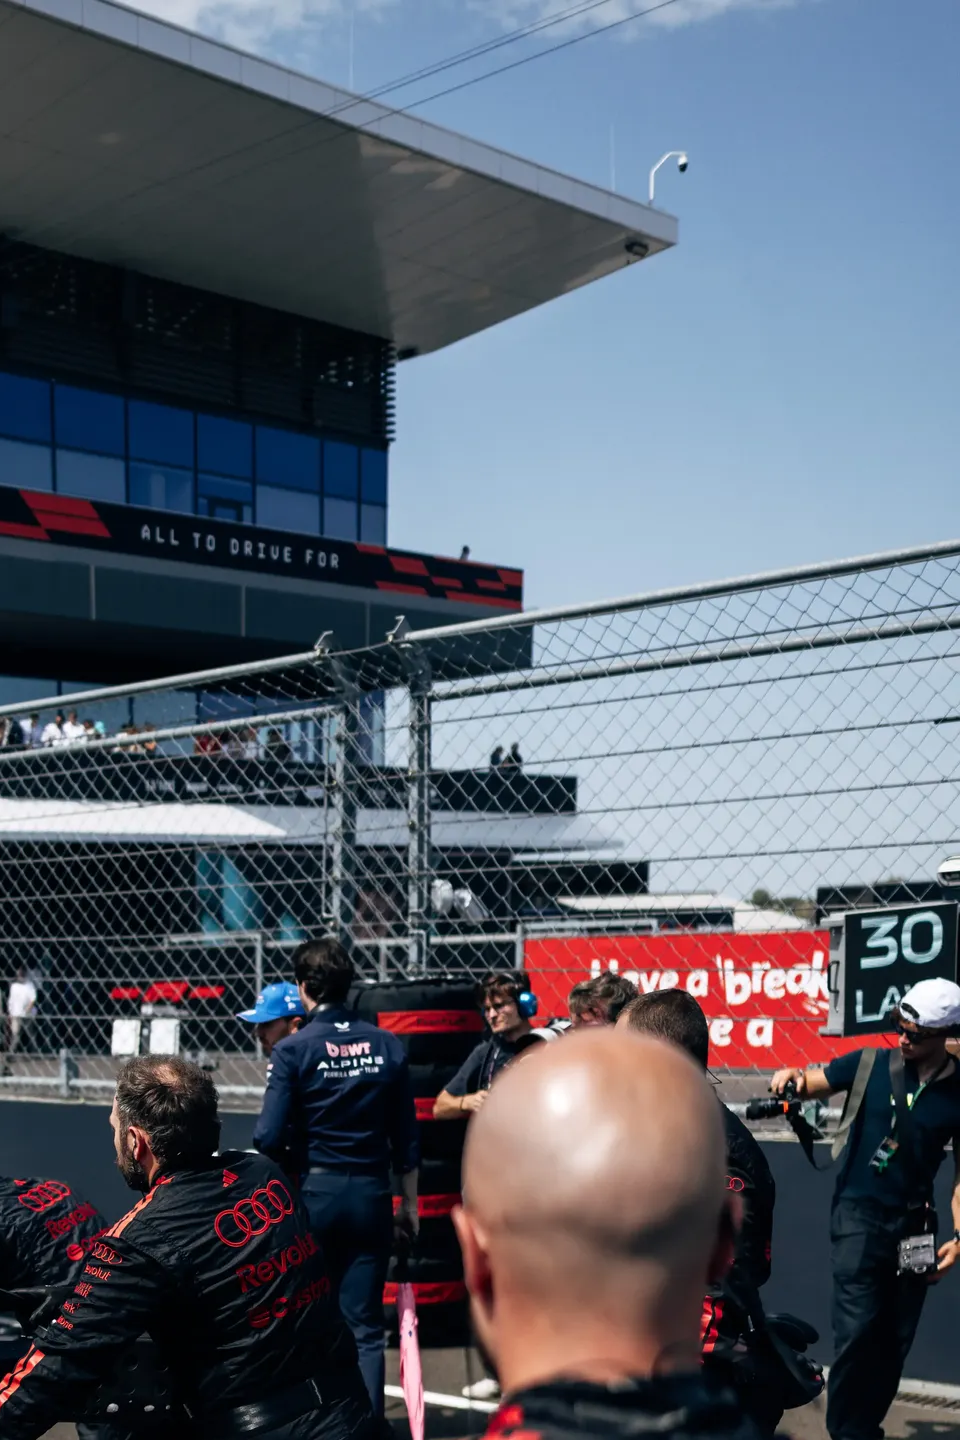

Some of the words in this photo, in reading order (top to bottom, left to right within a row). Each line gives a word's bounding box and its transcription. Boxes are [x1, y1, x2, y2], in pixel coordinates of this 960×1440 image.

[141, 524, 180, 546] ALL
[193, 532, 216, 551] TO
[230, 538, 293, 563] DRIVE
[305, 549, 340, 569] FOR
[861, 910, 944, 969] 30
[855, 984, 911, 1024] LA
[316, 1055, 385, 1071] ALPINE
[340, 1041, 371, 1058] BWT
